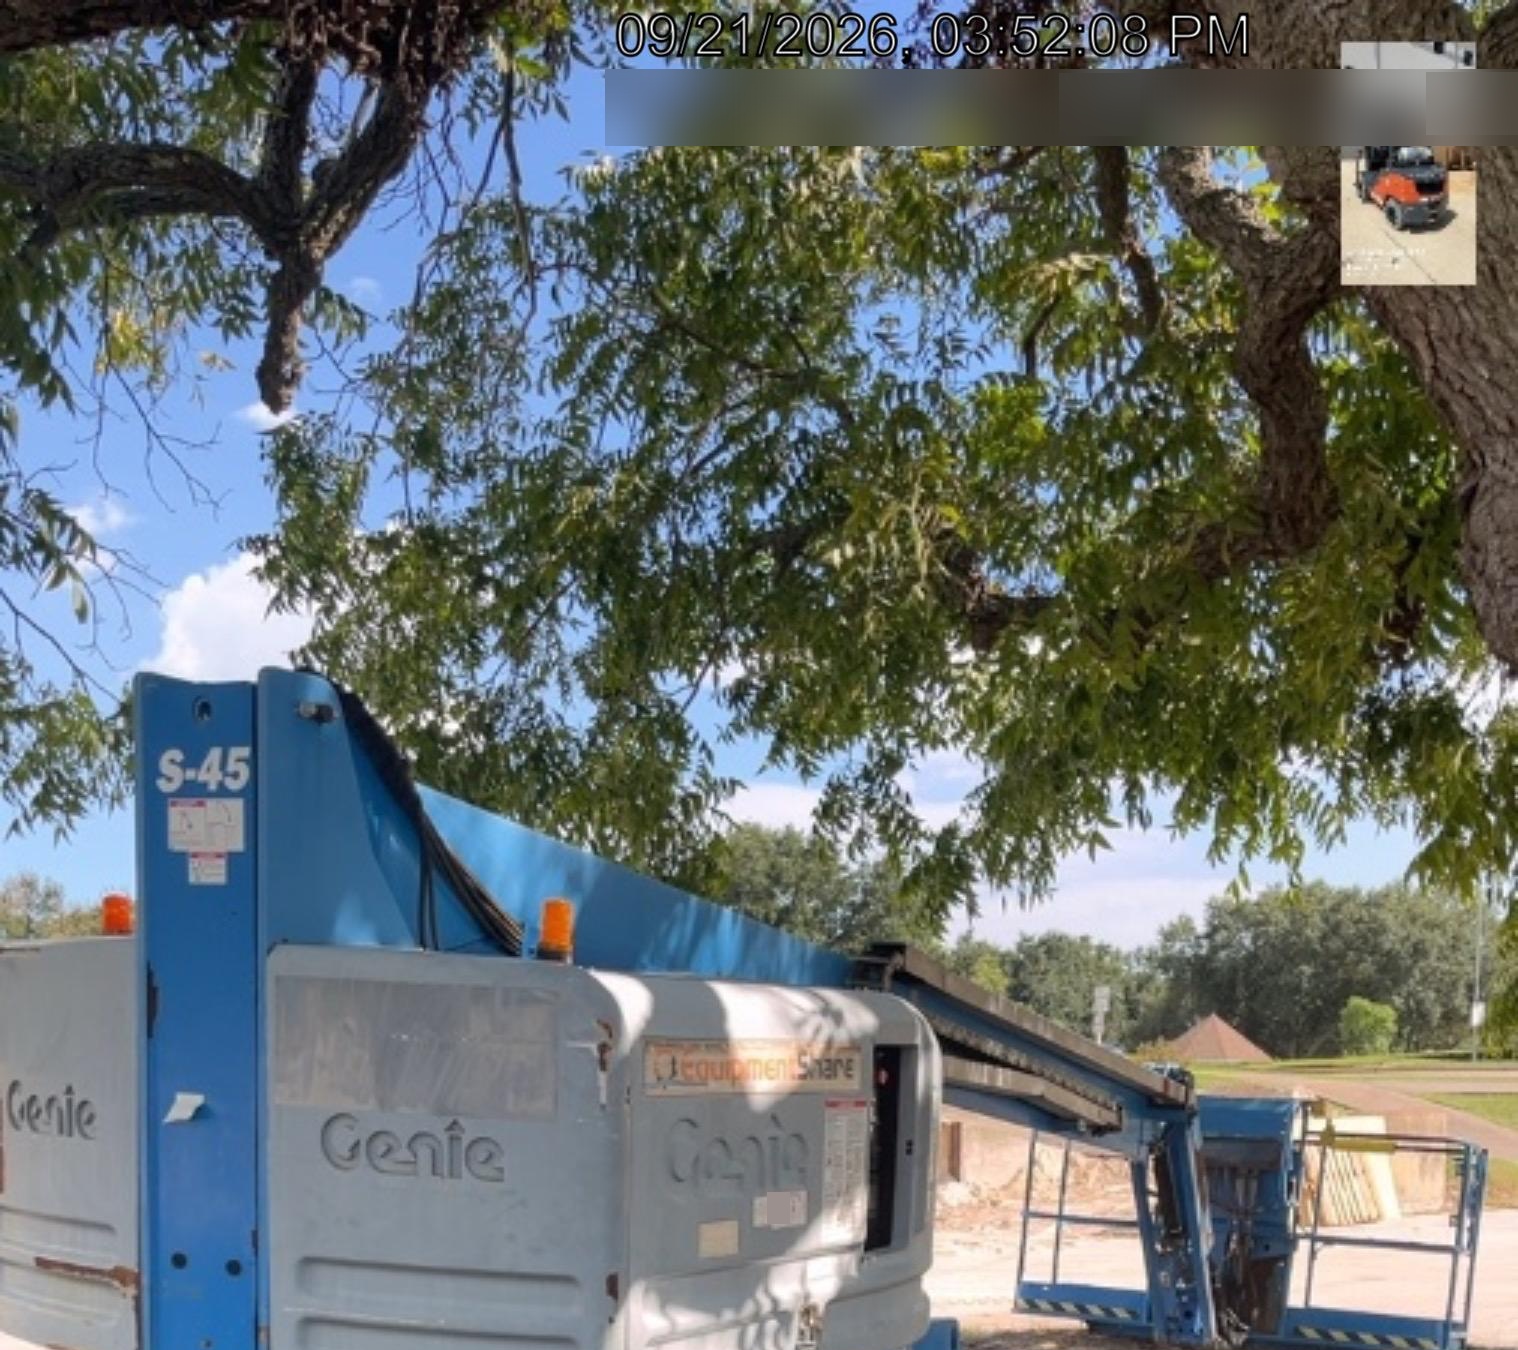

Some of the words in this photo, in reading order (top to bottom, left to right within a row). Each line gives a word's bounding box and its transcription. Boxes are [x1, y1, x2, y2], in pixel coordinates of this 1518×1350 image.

[155, 745, 252, 795] S-45
[7, 1078, 97, 1141] Genie
[319, 1112, 505, 1183] Genie
